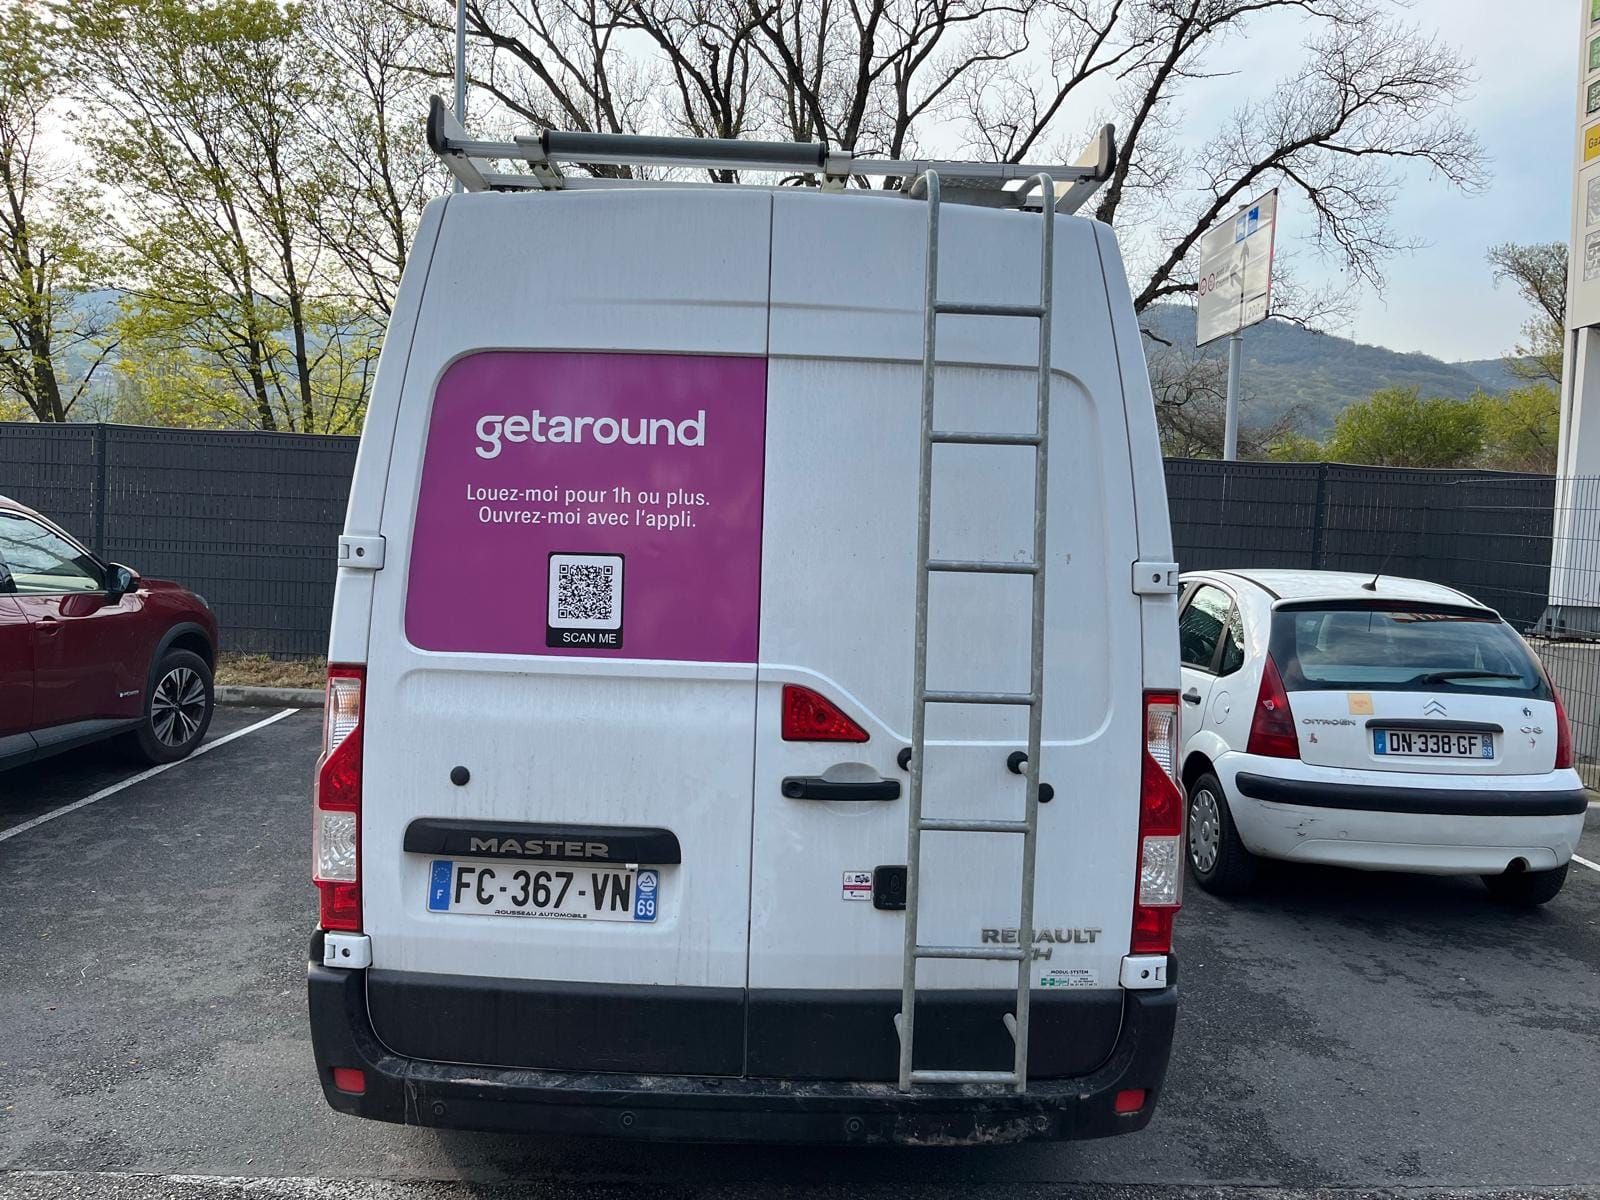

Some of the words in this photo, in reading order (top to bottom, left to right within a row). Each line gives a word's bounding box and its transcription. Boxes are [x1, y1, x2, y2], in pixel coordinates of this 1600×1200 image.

[475, 410, 706, 459] getaround
[466, 483, 558, 503] Louez-moi
[564, 488, 607, 507] pour
[613, 486, 631, 504] 1h
[637, 491, 660, 505] ou
[666, 489, 710, 509] plus.
[478, 505, 581, 526] Ouvrez-moi
[586, 511, 630, 527] avec
[635, 508, 697, 531] l'appli.
[562, 632, 596, 644] SCAN
[598, 633, 617, 644] ME
[1389, 732, 1478, 755] DN-338-GF
[1482, 746, 1493, 757] 69
[470, 836, 609, 858] MASTER
[436, 889, 444, 900] F
[454, 866, 632, 913] FC-367-VN
[637, 899, 655, 917] 69
[494, 909, 537, 917] ROUSSEAU
[982, 928, 1101, 944] REAULT
